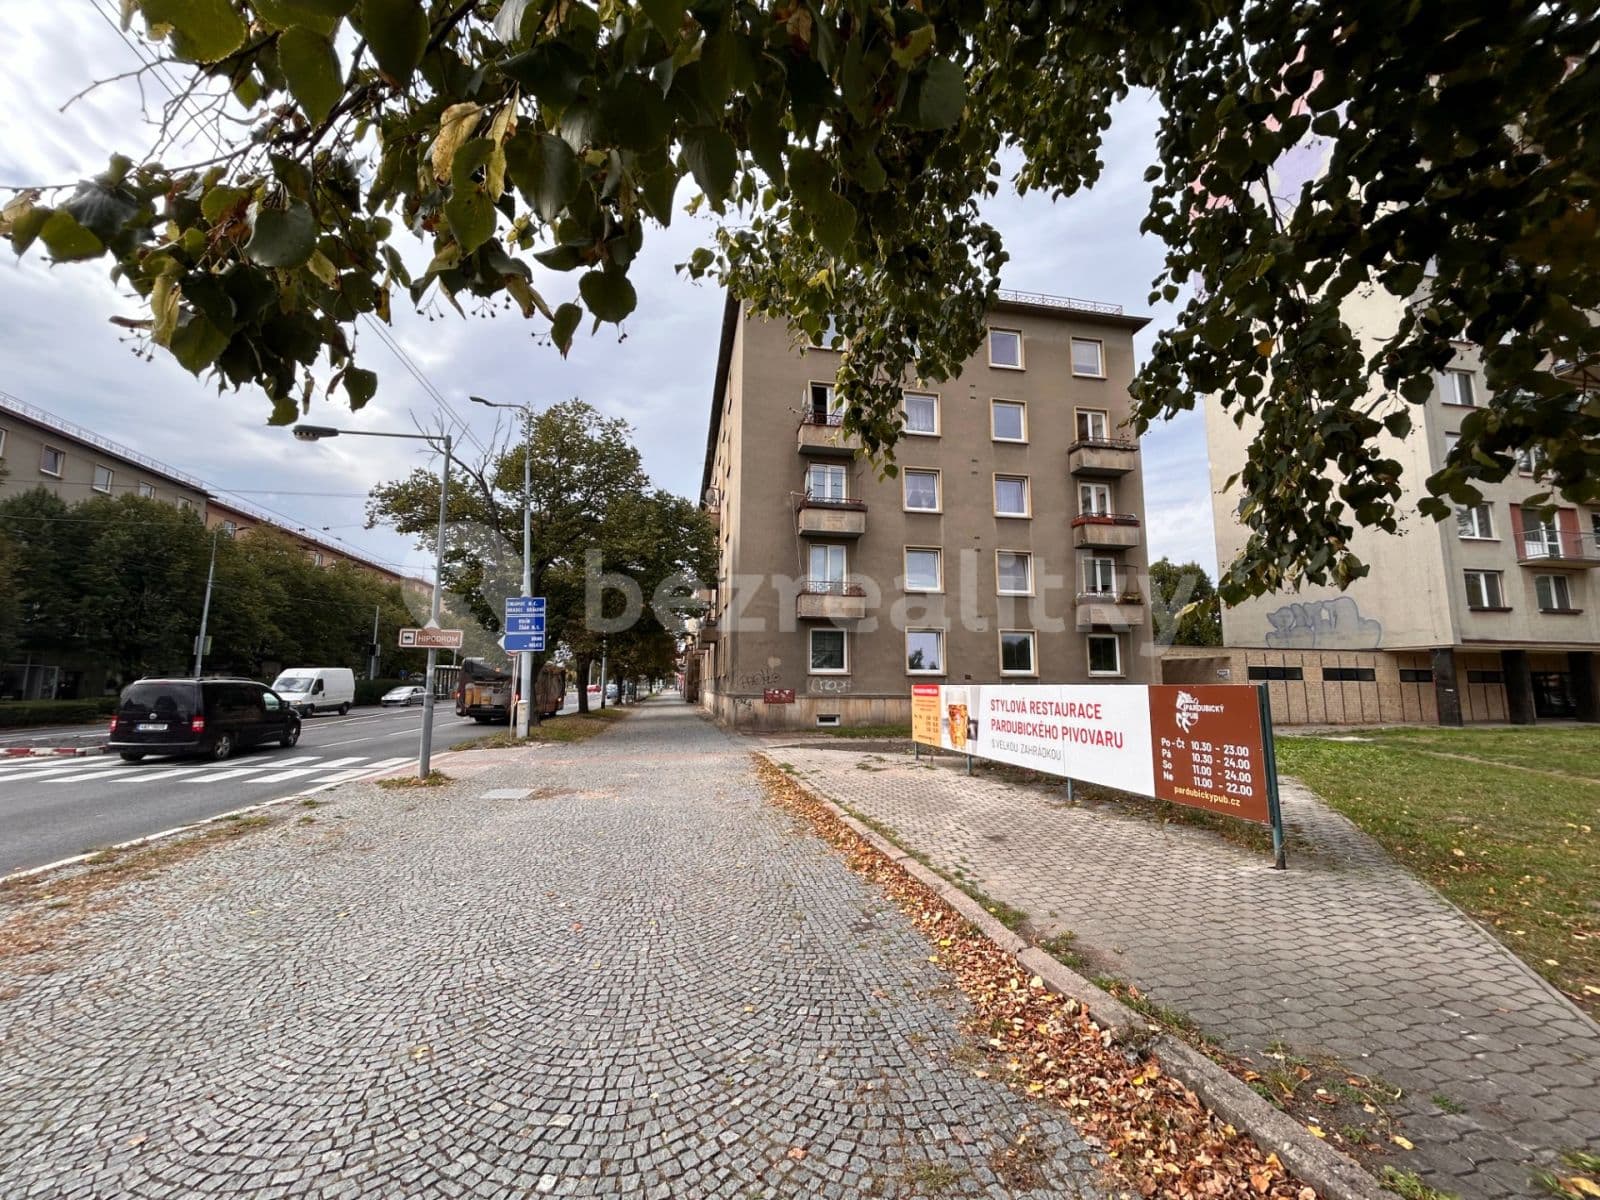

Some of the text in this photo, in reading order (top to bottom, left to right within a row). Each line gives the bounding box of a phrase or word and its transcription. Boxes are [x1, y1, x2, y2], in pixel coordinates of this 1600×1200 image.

[418, 635, 459, 644] HIPODROM
[990, 697, 1103, 720] STYLOVÁ RESTAURACE
[990, 718, 1124, 749] PARDUBICKÉHO PIVOVARU
[1161, 748, 1172, 759] Pá
[1191, 752, 1213, 764] 10.30
[1224, 757, 1251, 770] 24.00
[1191, 741, 1212, 752] 10.30
[1223, 745, 1249, 757] 23.00
[1162, 760, 1173, 770] So
[1192, 764, 1212, 776] 11.00
[1224, 769, 1252, 783] 24.00
[1163, 771, 1174, 782] Ne
[1193, 776, 1213, 789] 11.00
[1226, 782, 1253, 797] 22.00
[1174, 786, 1241, 807] pardubickypub.cz
